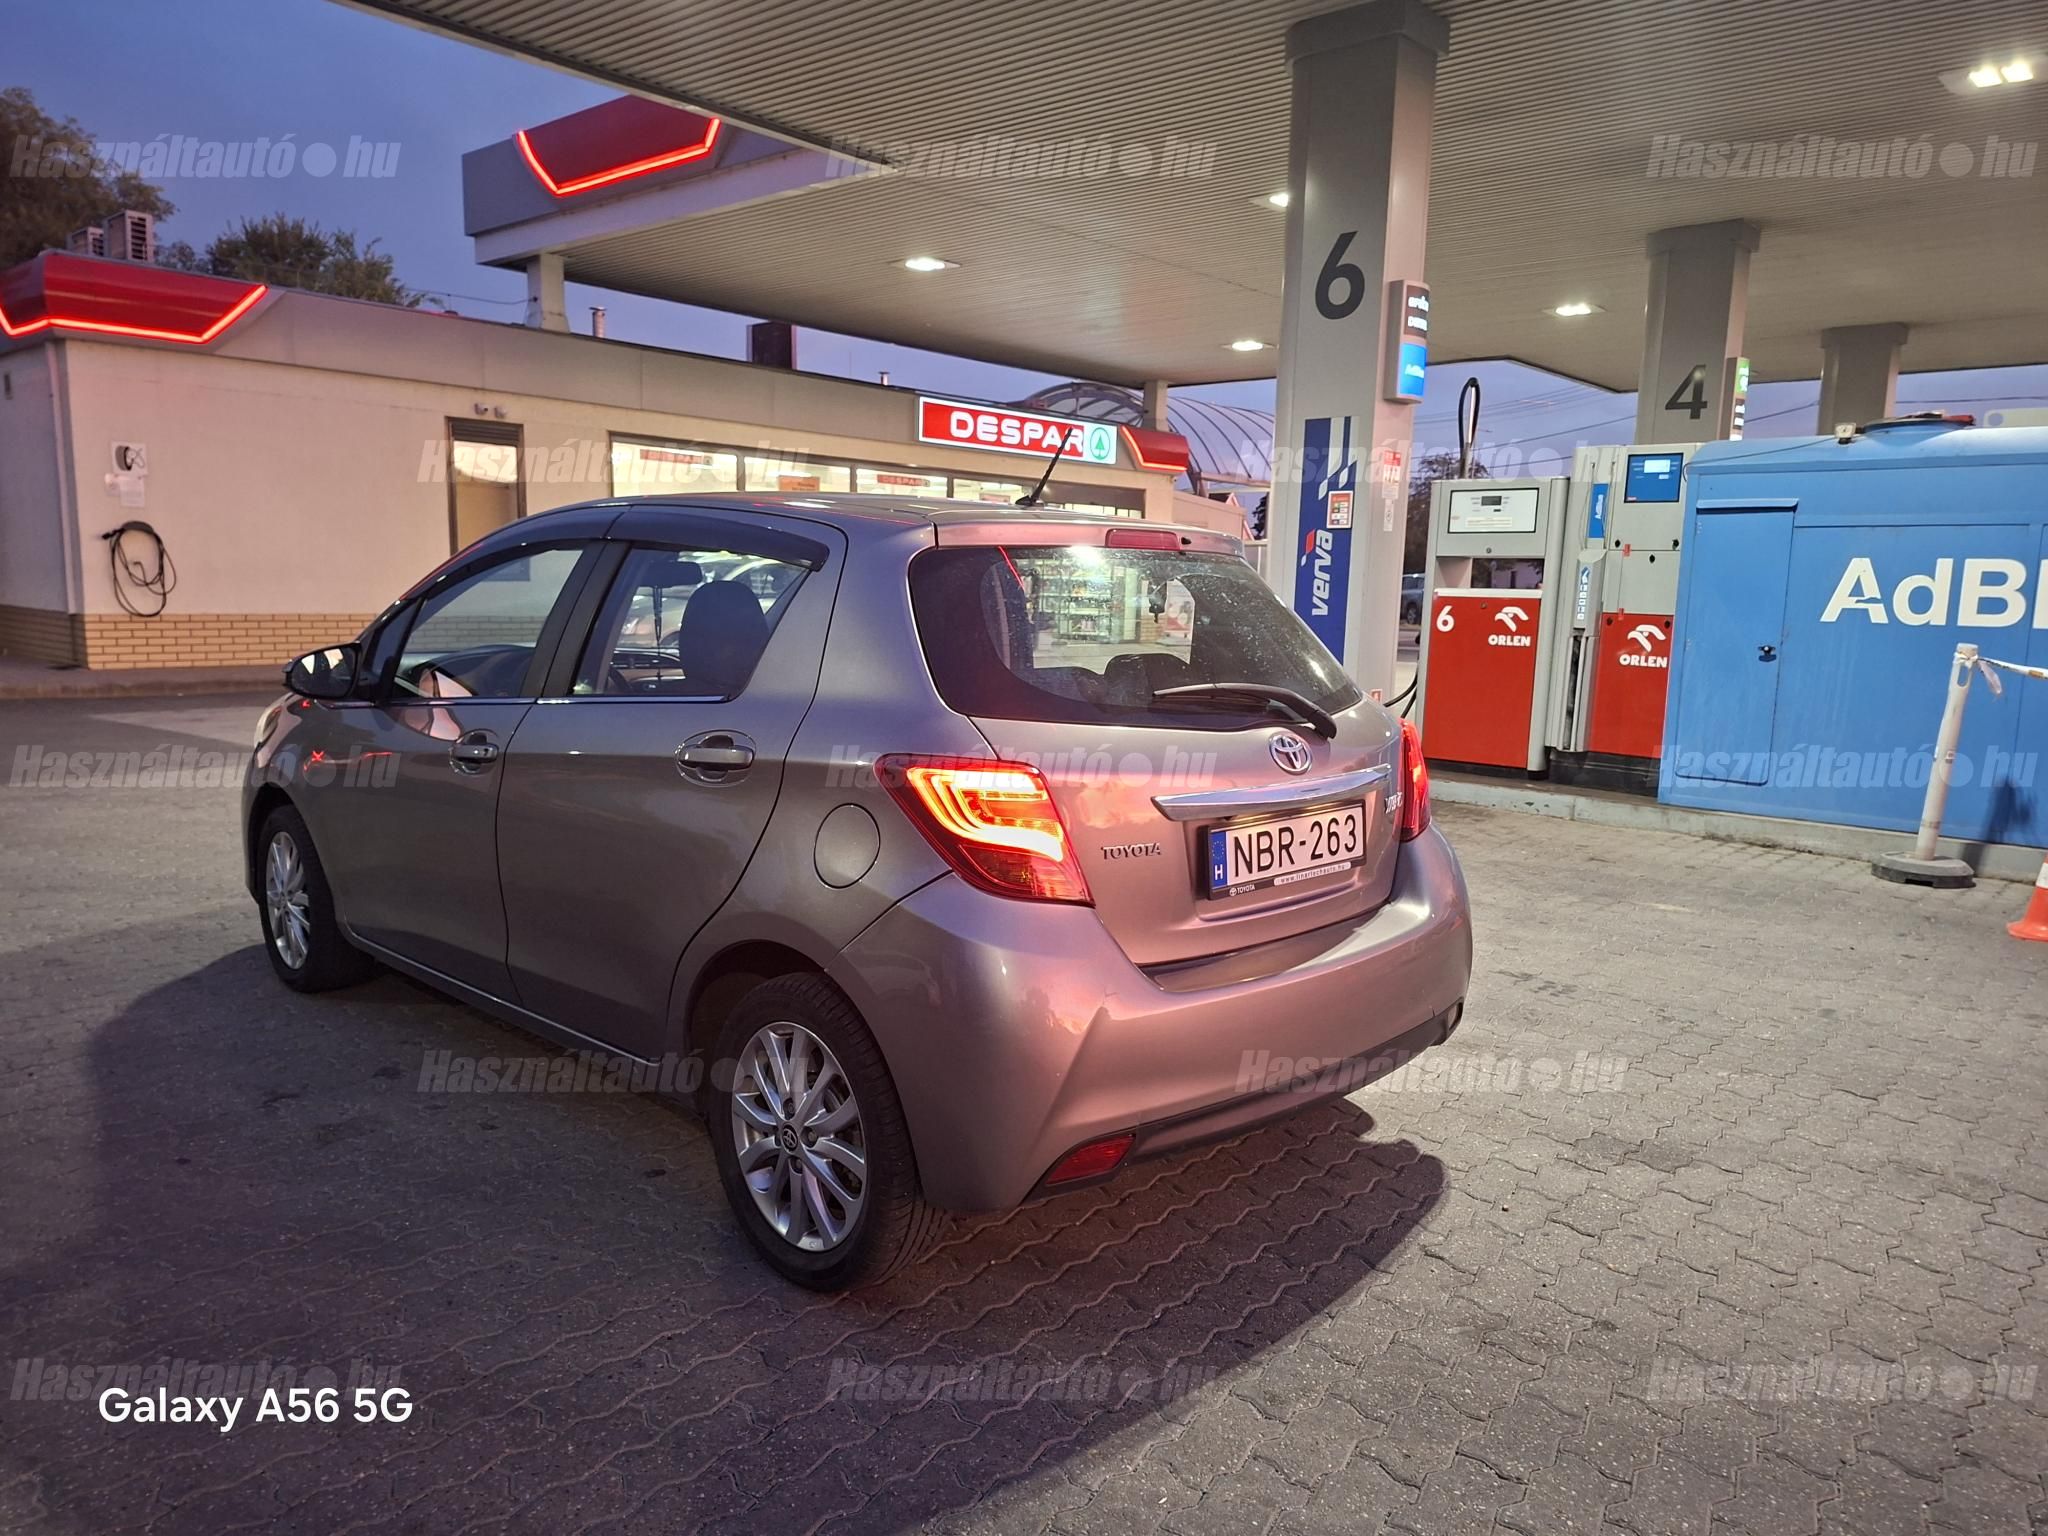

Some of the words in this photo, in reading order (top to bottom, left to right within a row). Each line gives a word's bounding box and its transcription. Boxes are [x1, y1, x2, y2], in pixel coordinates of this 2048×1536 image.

[1314, 231, 1365, 320] 6
[1665, 364, 1708, 420] 4
[950, 411, 1084, 453] DESPAR
[1311, 529, 1333, 616] verva
[1436, 605, 1455, 632] 6
[1488, 635, 1531, 647] ORLEN
[1619, 654, 1667, 668] ORLEN
[1100, 843, 1161, 860] TOYOTA
[1214, 864, 1224, 880] H
[1234, 813, 1357, 878] NBR-263
[1237, 884, 1256, 895] TOYOTA
